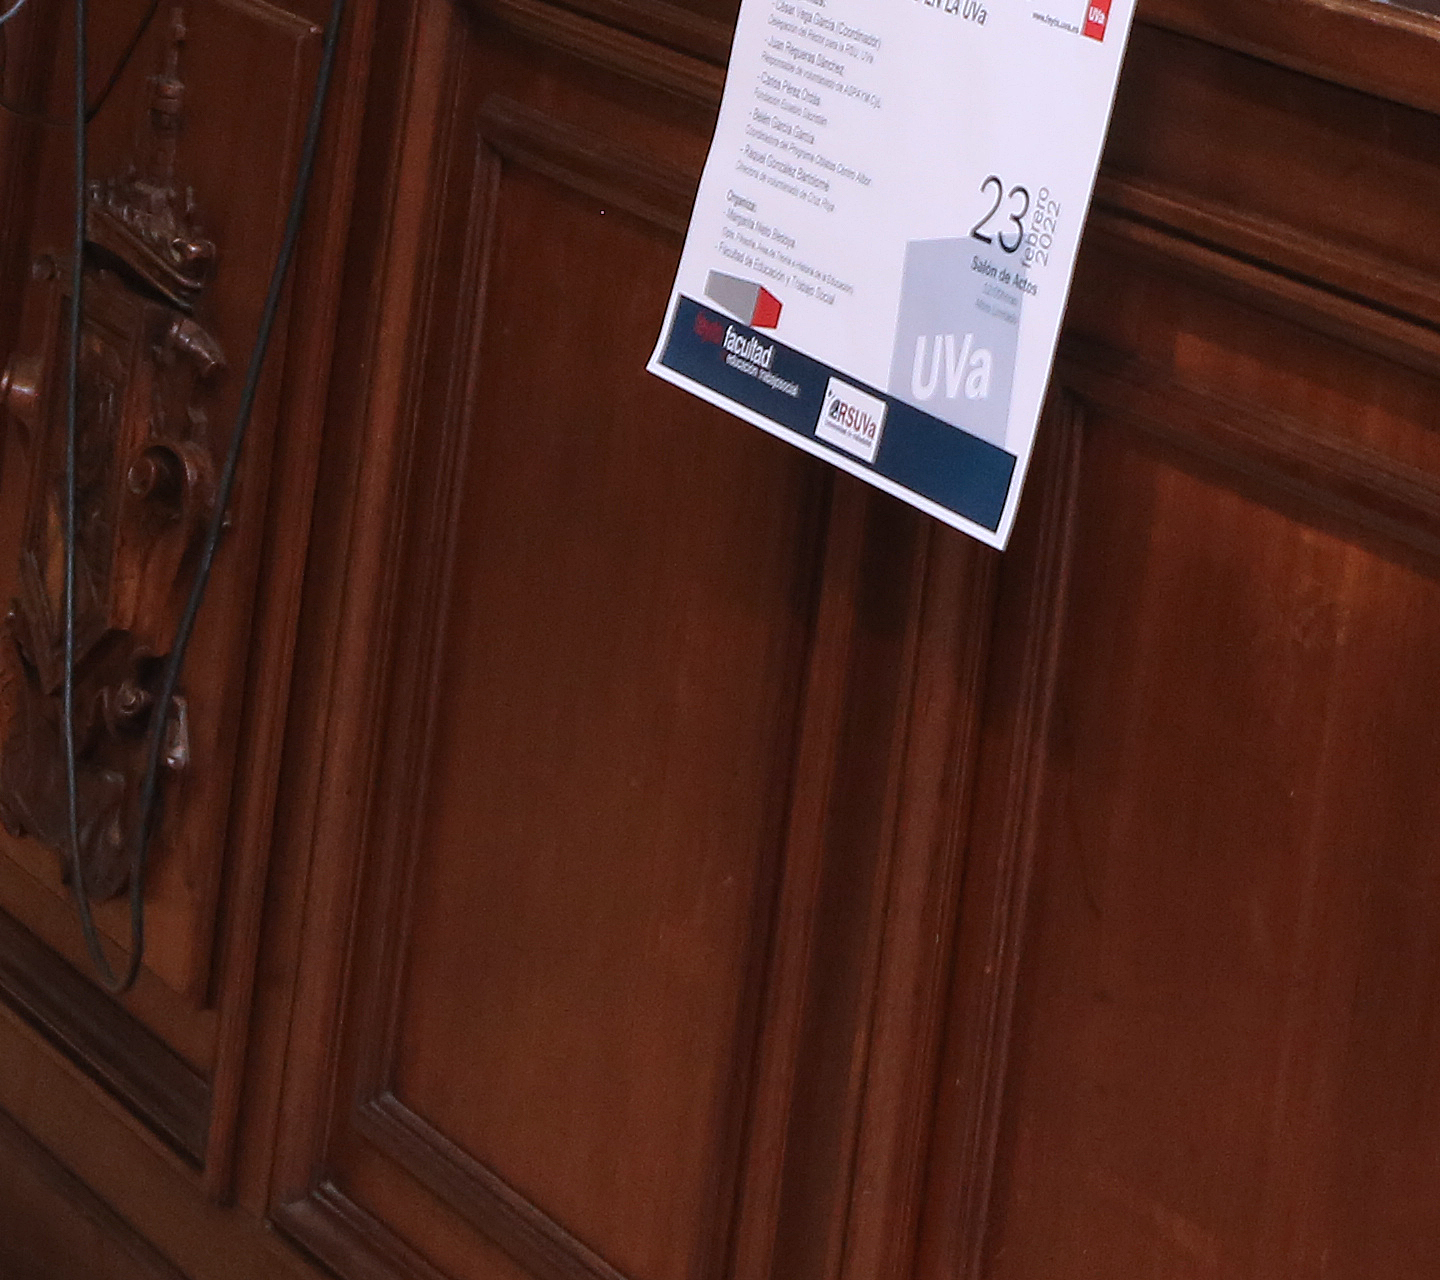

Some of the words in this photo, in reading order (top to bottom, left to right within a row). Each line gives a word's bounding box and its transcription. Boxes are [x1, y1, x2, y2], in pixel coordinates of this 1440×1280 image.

[962, 0, 987, 25] UVa
[1088, 6, 1105, 24] UVa
[970, 175, 1029, 253] 23
[1021, 184, 1050, 270] febrero
[1034, 198, 1060, 268] 2022
[970, 255, 997, 279] Salón
[997, 266, 1011, 285] de
[1012, 273, 1038, 296] Actos
[723, 325, 773, 368] facultad
[912, 334, 992, 400] UVa
